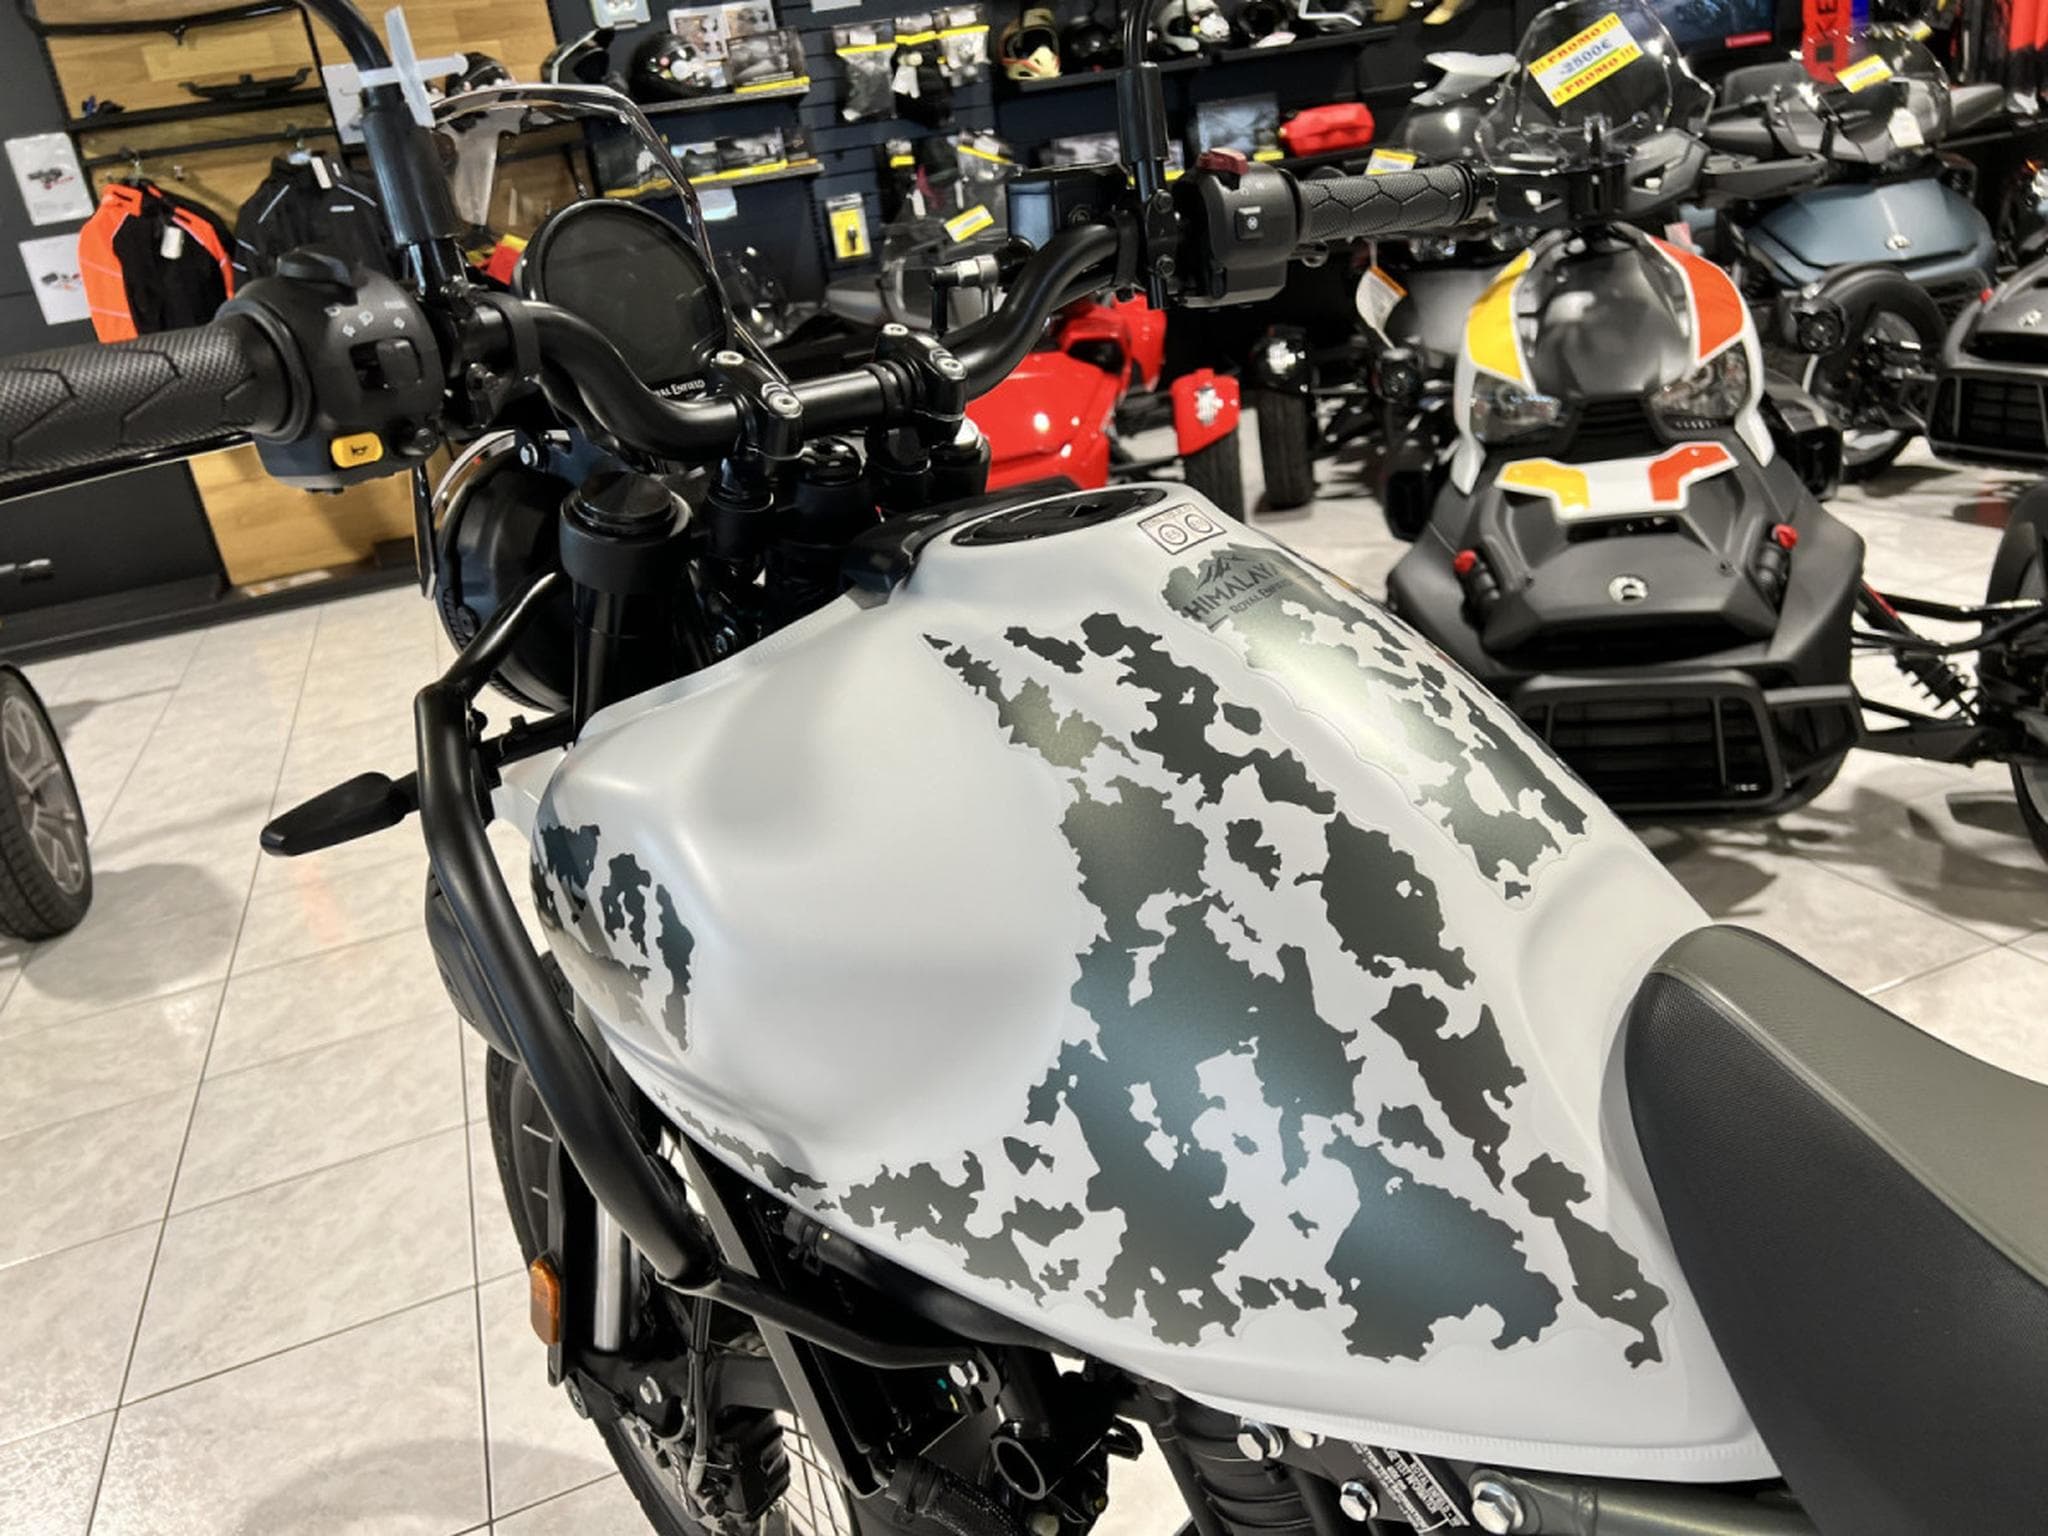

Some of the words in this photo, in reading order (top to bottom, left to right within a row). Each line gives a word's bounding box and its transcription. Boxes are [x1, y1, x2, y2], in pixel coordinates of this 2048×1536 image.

[1548, 27, 1601, 64] PROMO
[1565, 57, 1618, 93] PROMO
[1182, 562, 1277, 620] HIMALAY
[1230, 596, 1263, 613] ROYAL
